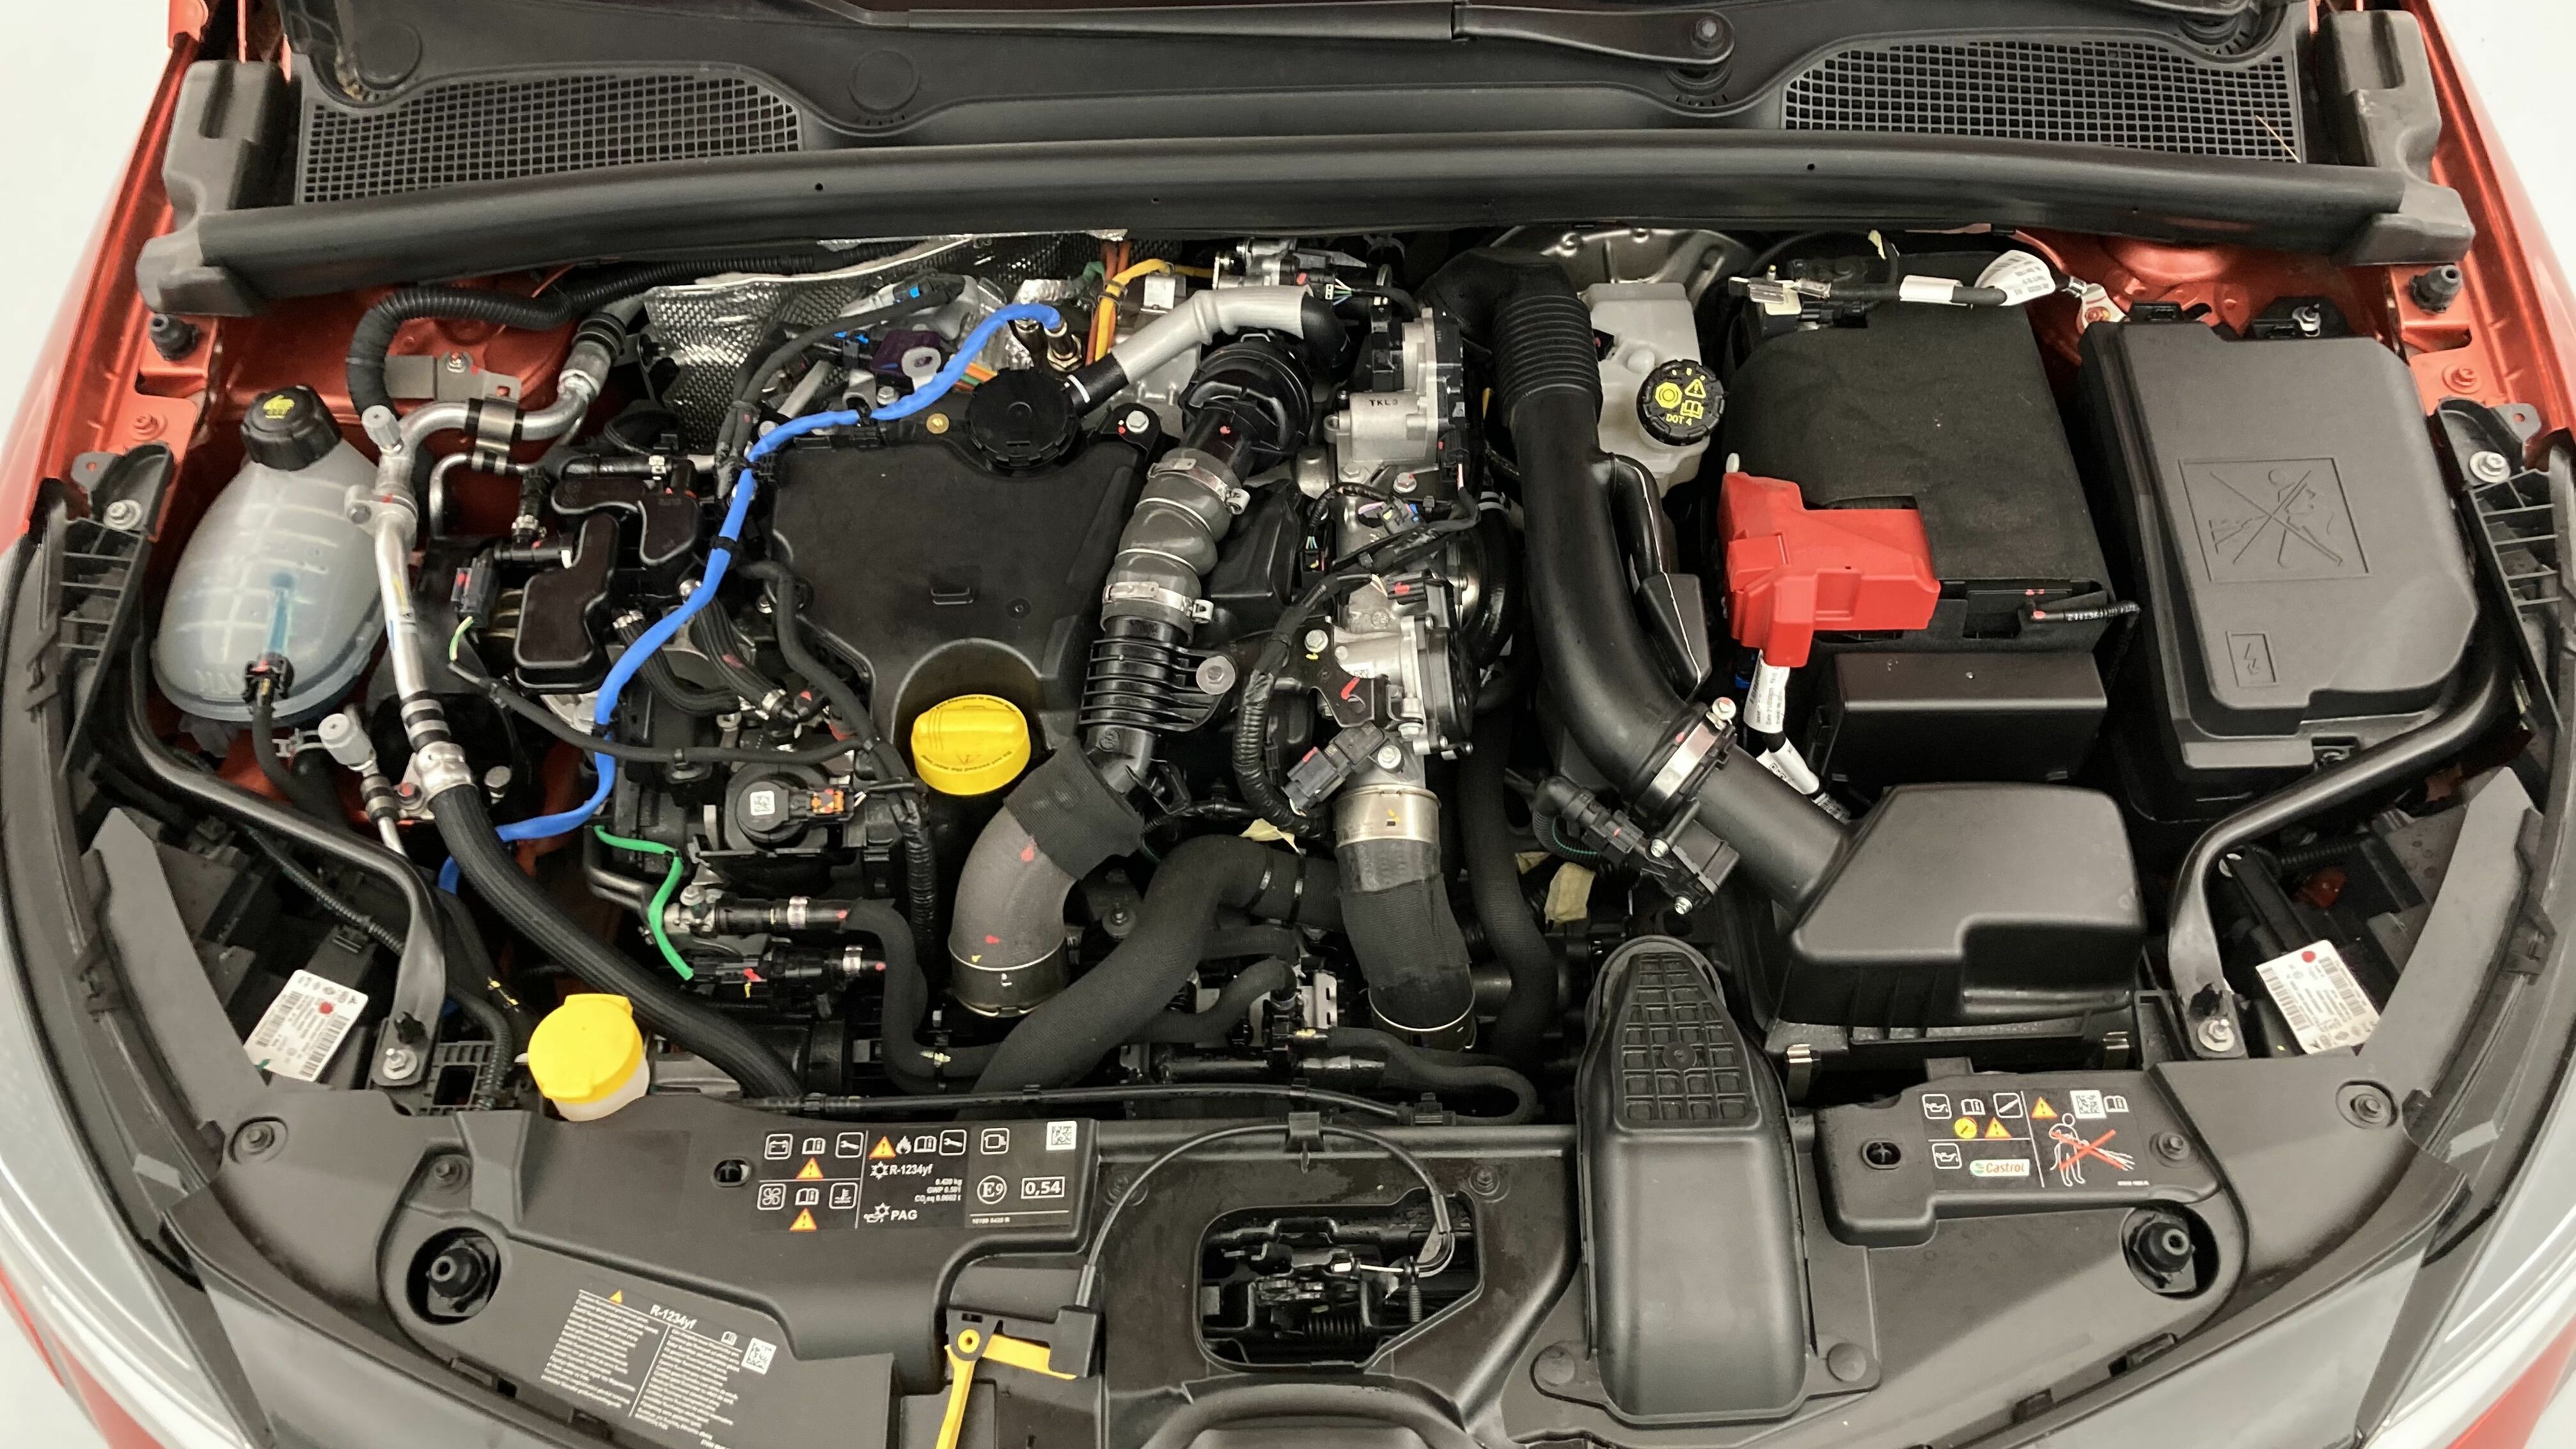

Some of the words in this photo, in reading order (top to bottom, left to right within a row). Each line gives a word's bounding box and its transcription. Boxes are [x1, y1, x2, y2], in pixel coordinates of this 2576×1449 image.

[1666, 414, 1685, 424] DOT
[1686, 418, 1693, 426] 4
[889, 1163, 934, 1177] R-1234yf
[1986, 1162, 2025, 1173] Castrol
[982, 1182, 1004, 1198] E9
[1025, 1181, 1062, 1196] 0,54
[890, 1209, 918, 1221] PAG
[650, 1304, 698, 1330] R-1234yf
